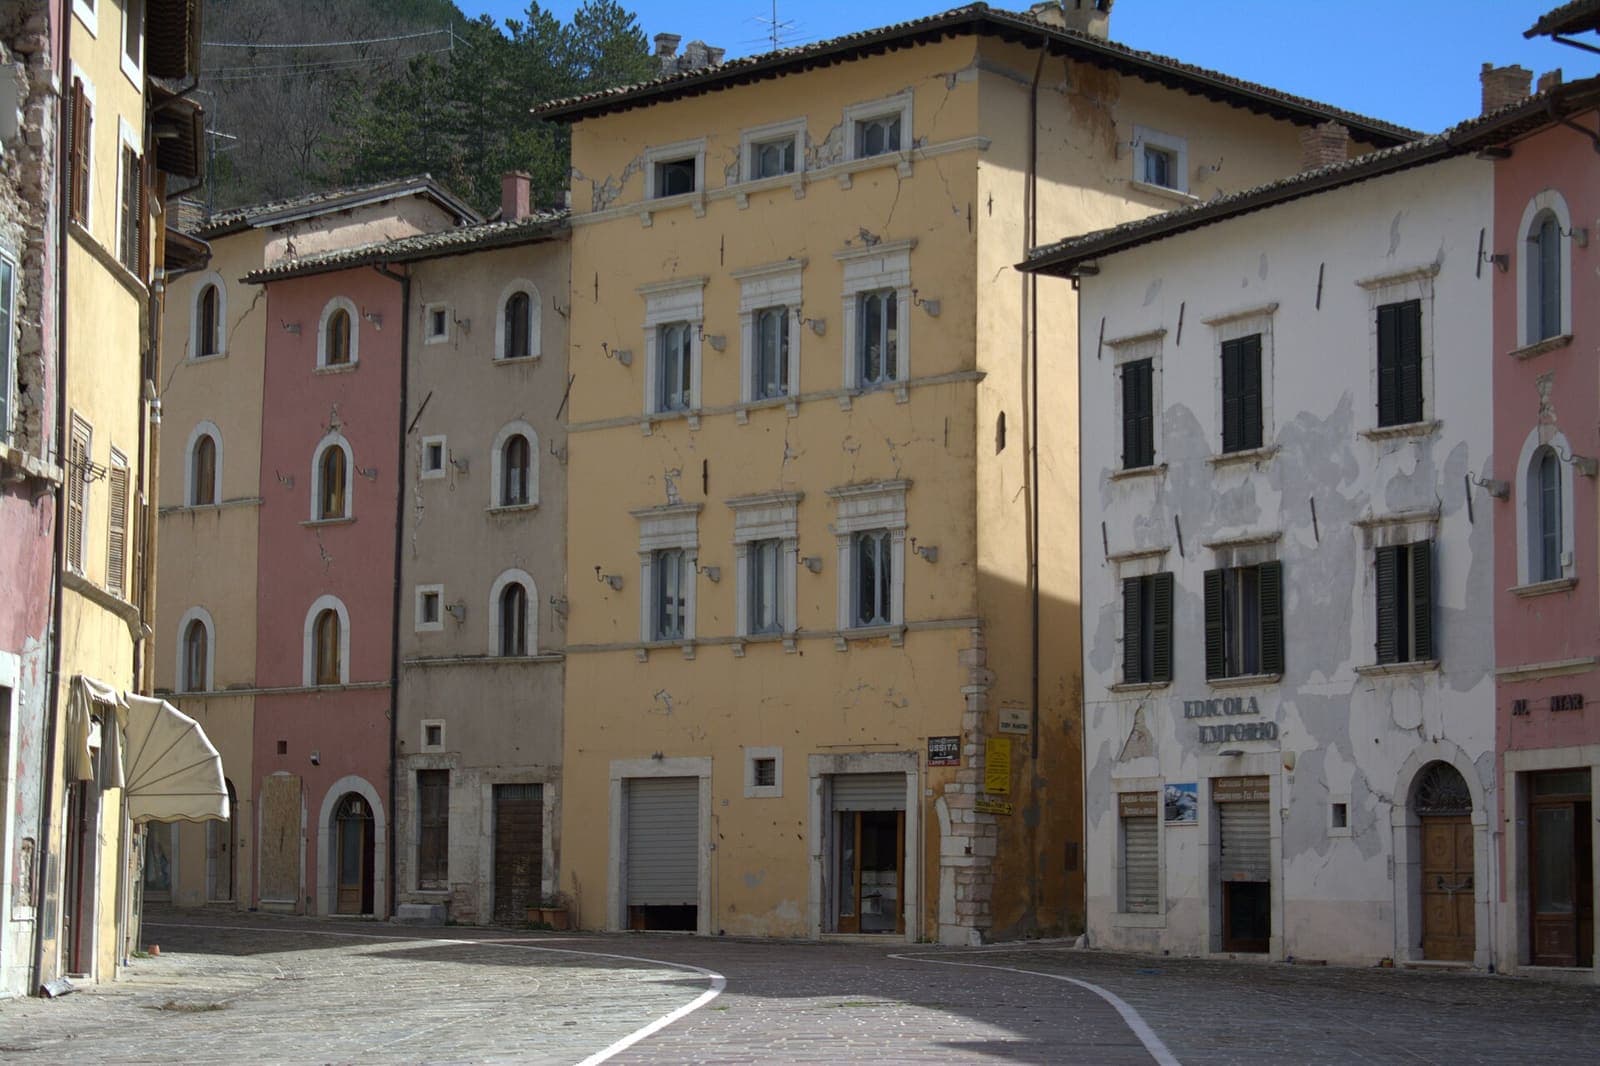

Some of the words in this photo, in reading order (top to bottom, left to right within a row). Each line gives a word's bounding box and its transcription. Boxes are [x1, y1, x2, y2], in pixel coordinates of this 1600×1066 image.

[1183, 696, 1259, 719] EDICOLA
[1198, 721, 1278, 744] EMPORIO
[929, 743, 958, 752] USSITA
